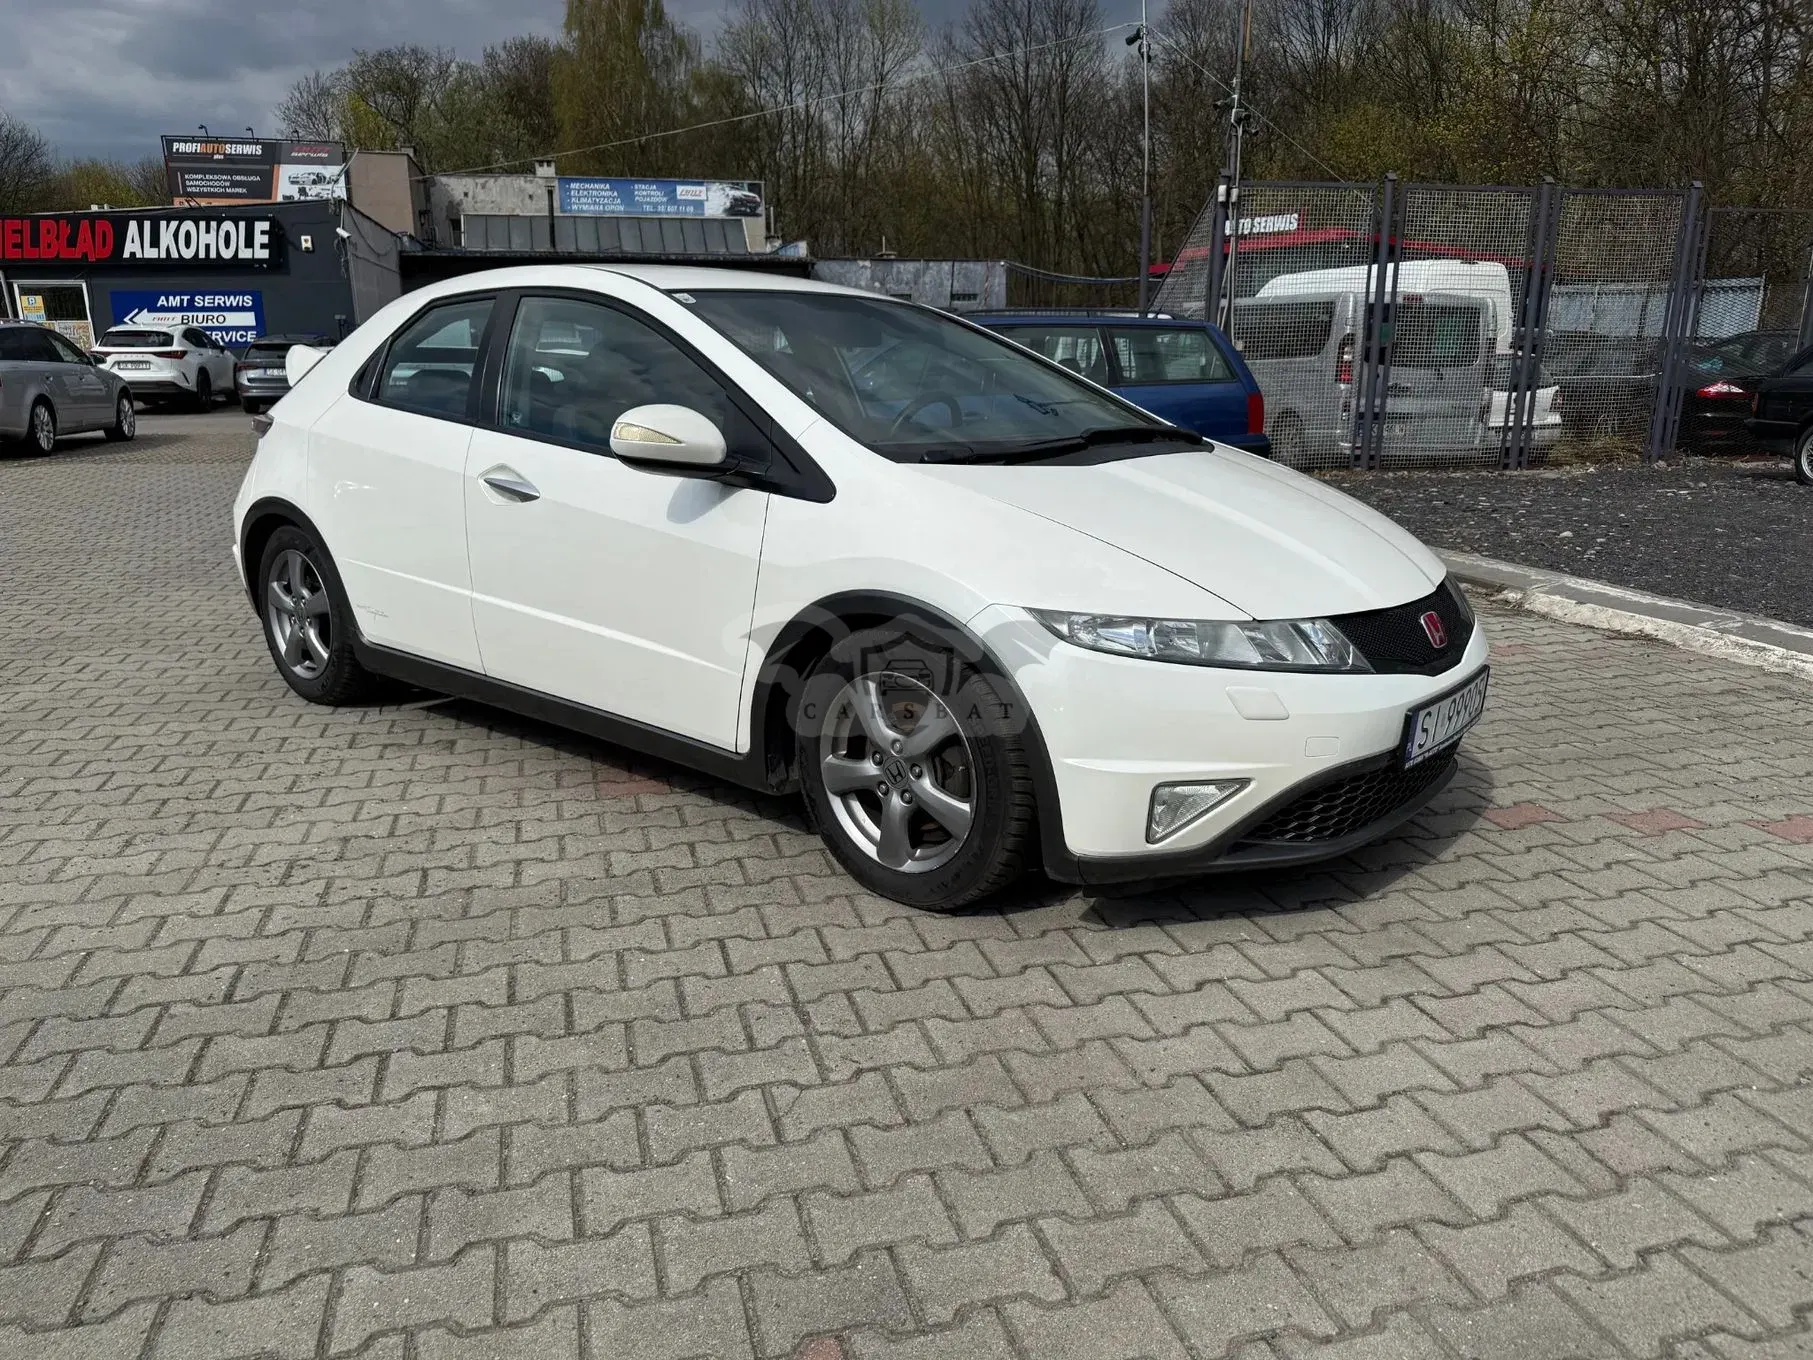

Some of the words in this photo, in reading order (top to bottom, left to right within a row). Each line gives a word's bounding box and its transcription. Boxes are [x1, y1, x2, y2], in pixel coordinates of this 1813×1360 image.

[172, 142, 262, 155] PROFIAUTOSERWIS
[1225, 219, 1251, 236] ATO
[1252, 213, 1298, 234] SERWIS
[123, 220, 270, 259] ALKOHOLE
[156, 295, 190, 307] AMT
[194, 295, 253, 307] SERWIS
[181, 314, 226, 325] BIURO
[1418, 705, 1441, 749] SI
